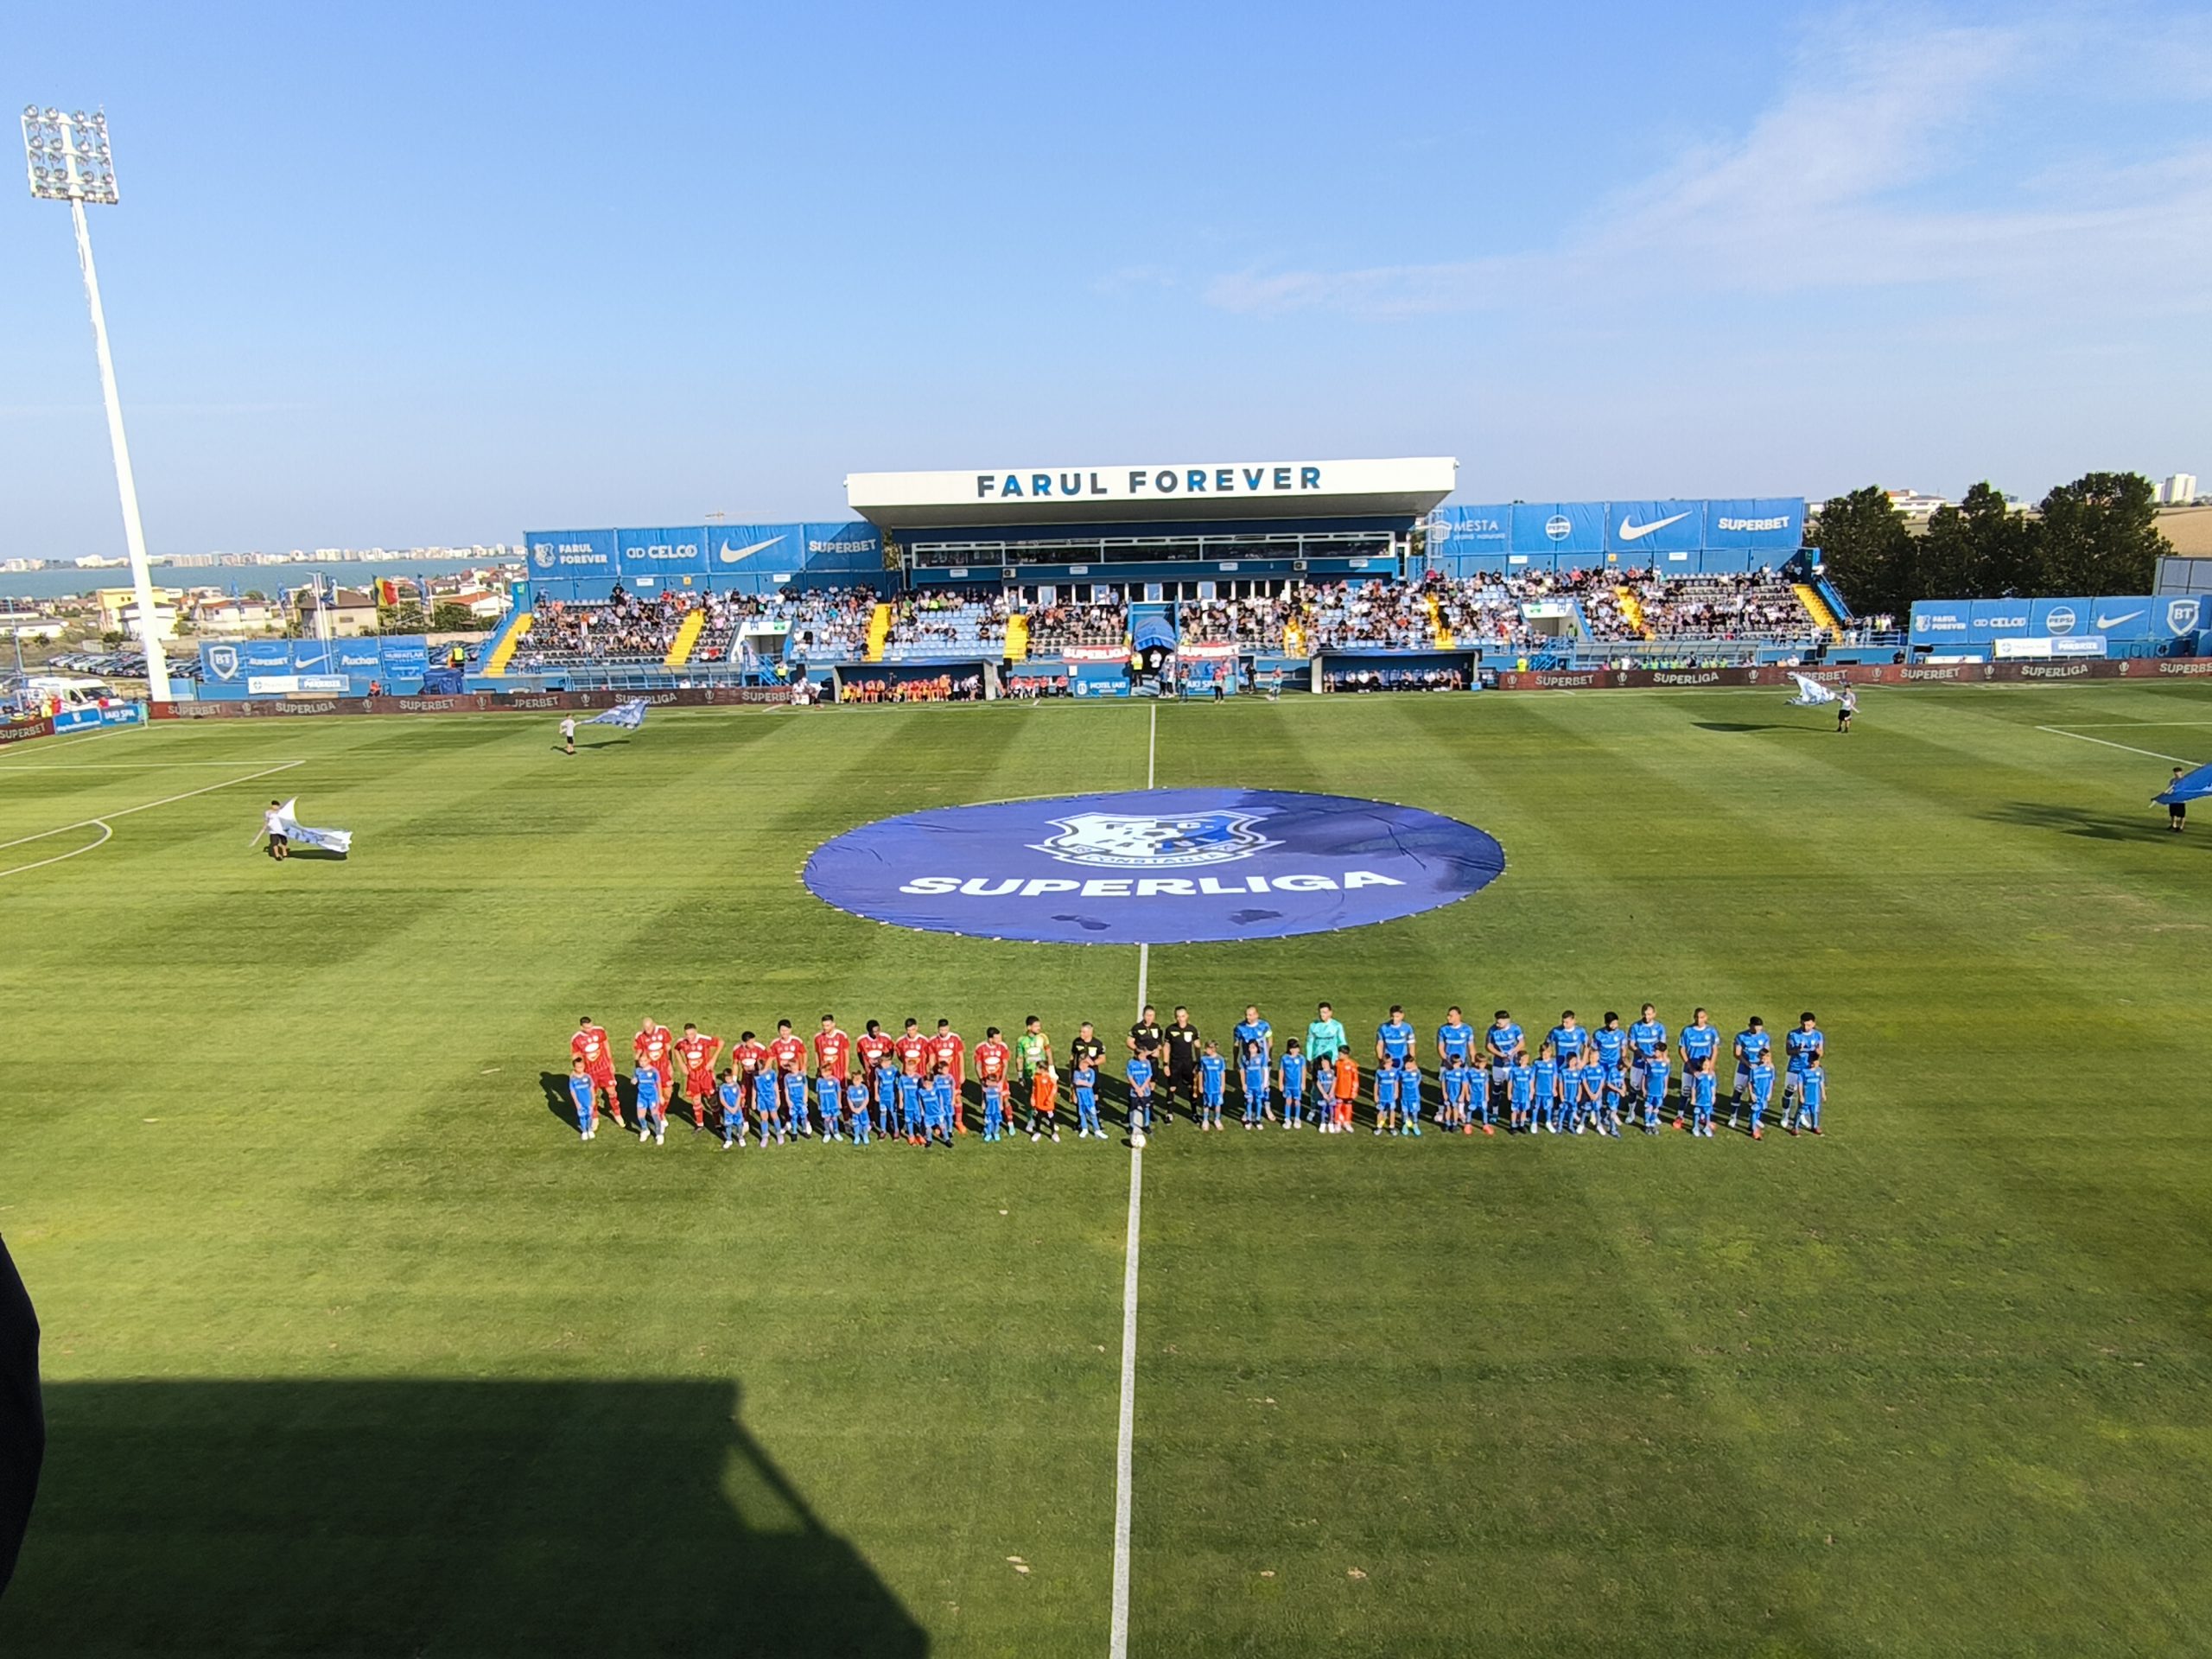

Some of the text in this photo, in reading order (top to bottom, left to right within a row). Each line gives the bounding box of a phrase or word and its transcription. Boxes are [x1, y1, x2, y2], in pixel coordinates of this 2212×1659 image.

[977, 467, 1321, 498] FARUL FOREVER
[1453, 519, 1499, 531] MESTA
[1718, 516, 1789, 531] SUPERBET
[558, 543, 593, 554] FARUL
[648, 544, 698, 559] CELCO
[809, 539, 876, 553] SUPERBET
[560, 554, 608, 564] FOREVER
[2174, 608, 2194, 620] BT
[214, 654, 232, 664] BT
[1900, 667, 1961, 679] SUPERBET
[2021, 664, 2088, 677] SUPERLIGA
[1535, 675, 1594, 687] SUPERBET
[1653, 671, 1719, 684] SUPERLIGA
[168, 705, 221, 715] SUPERBET
[276, 702, 336, 714] SUPERLIGA
[399, 699, 454, 710] SUPERBET
[0, 722, 45, 740] SUPERBET
[899, 871, 1407, 897] SUPERLIGA
